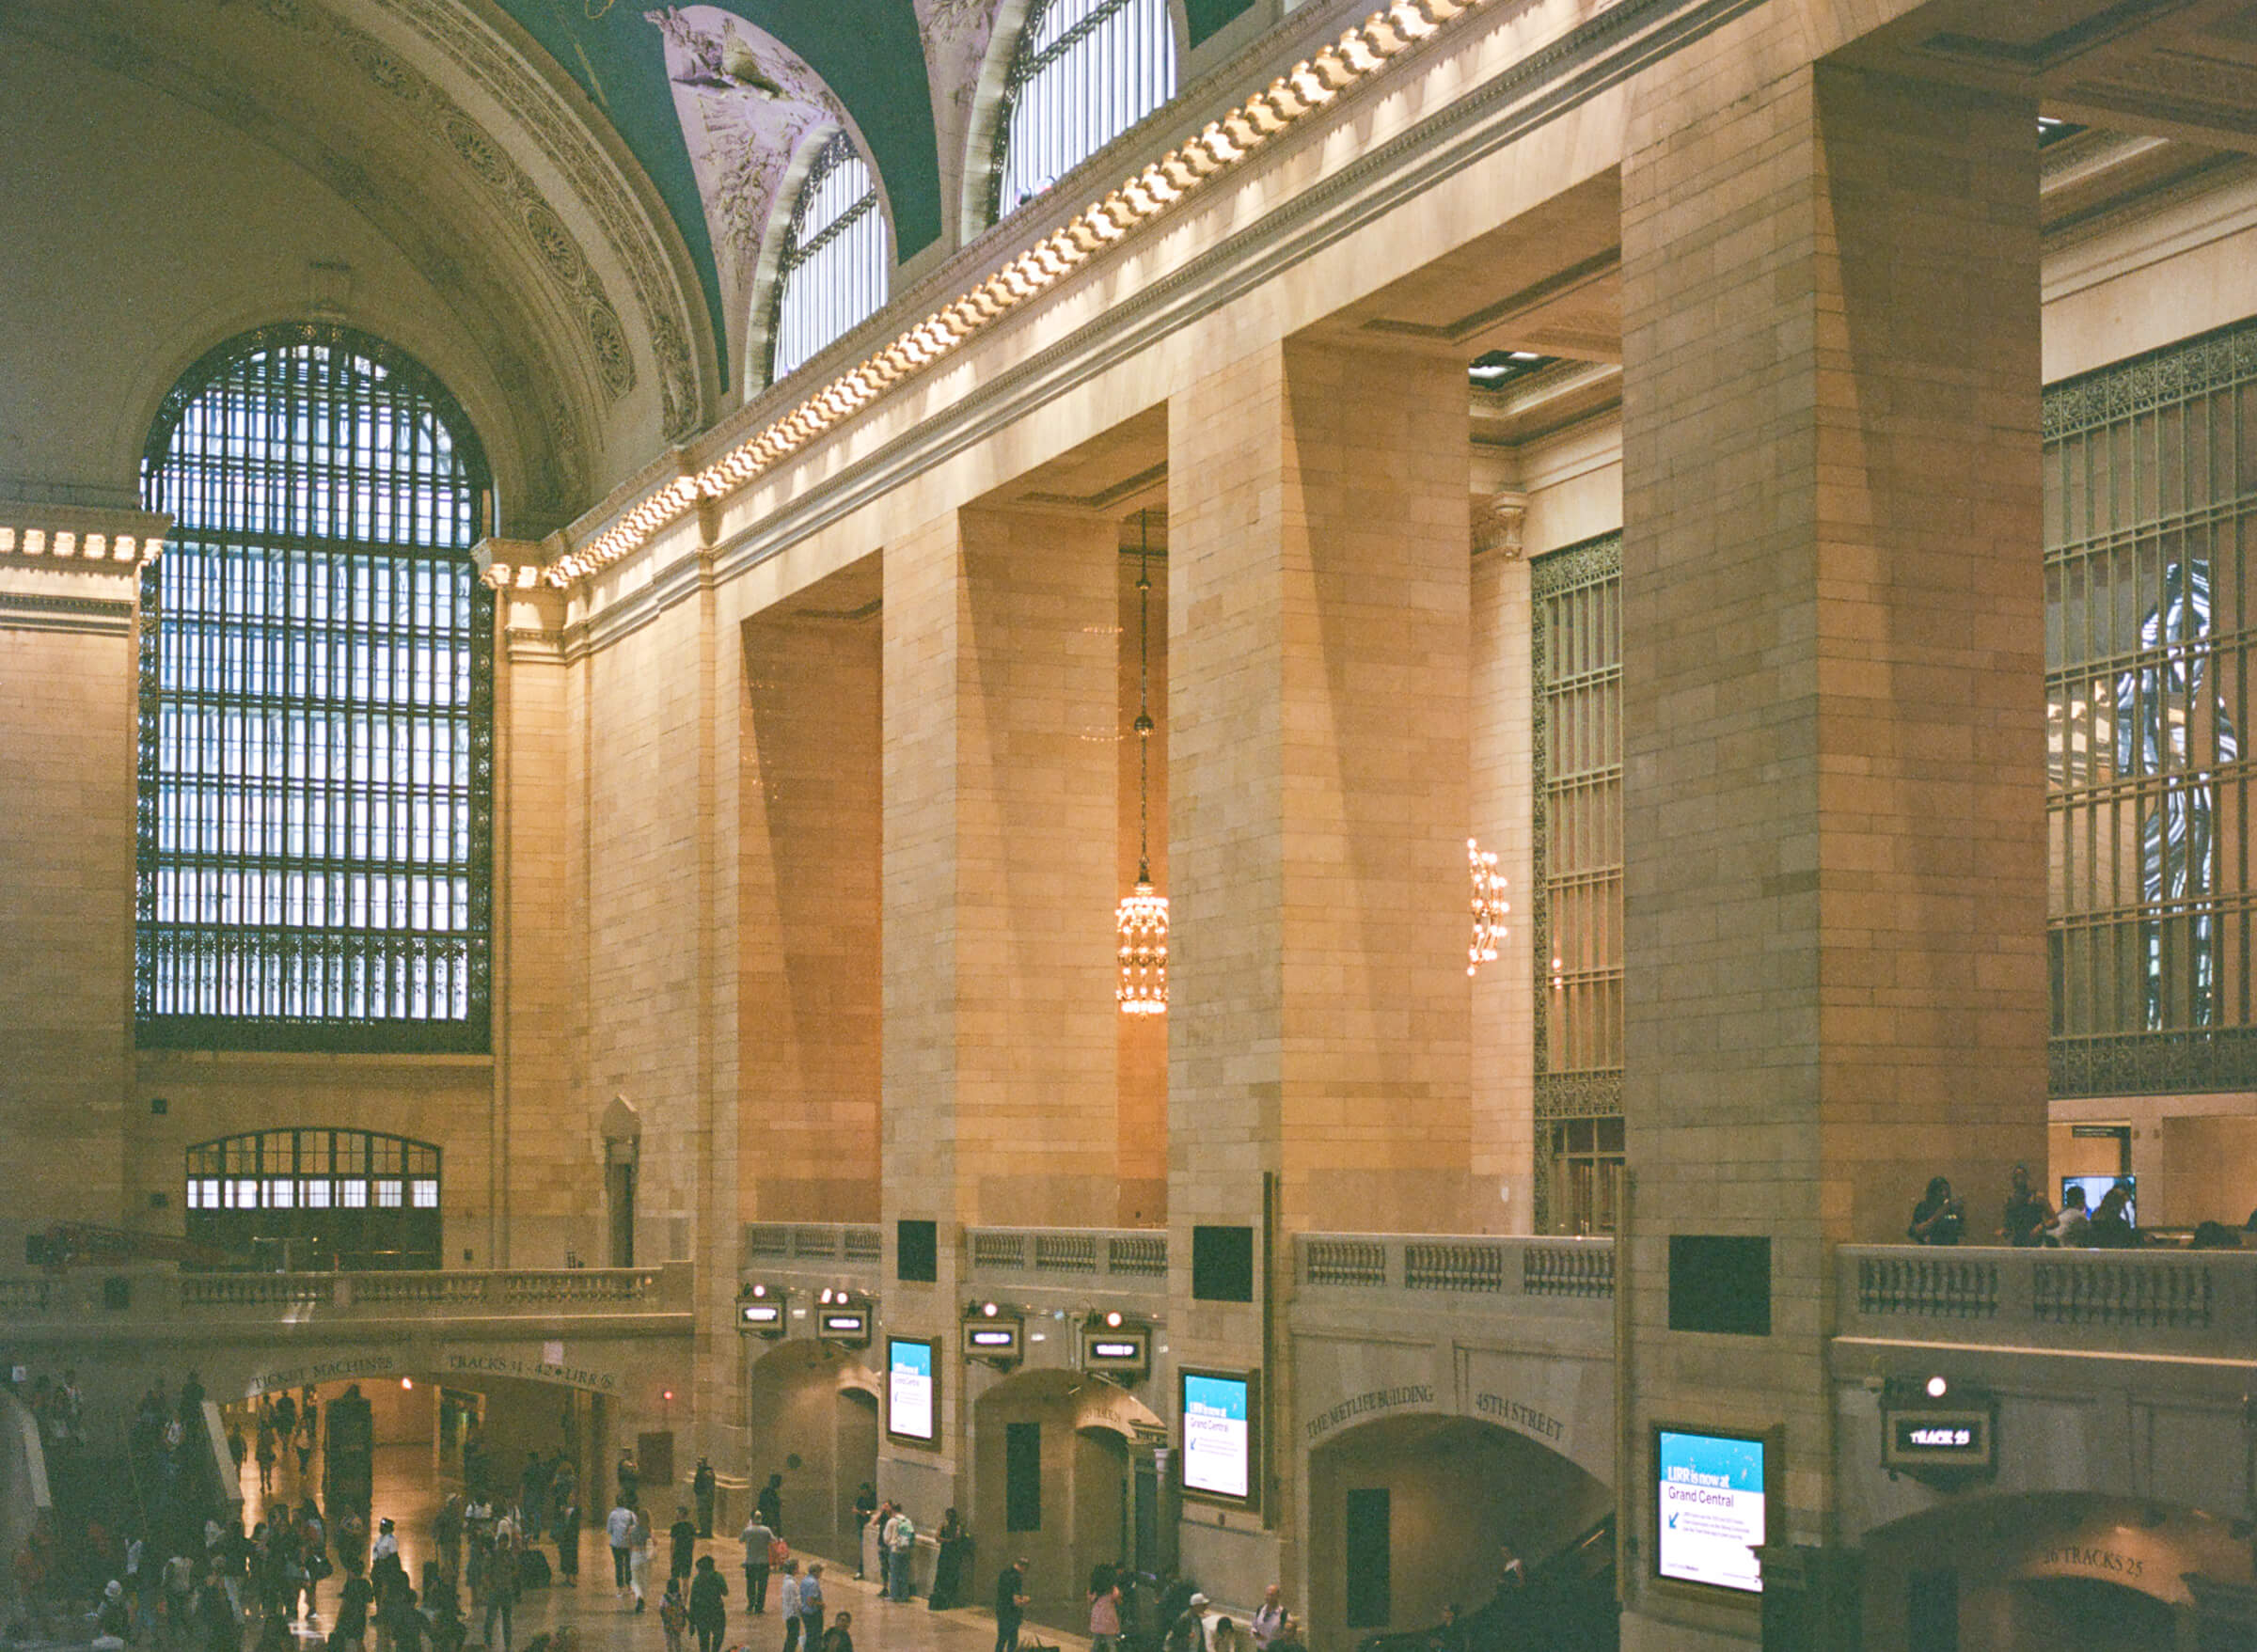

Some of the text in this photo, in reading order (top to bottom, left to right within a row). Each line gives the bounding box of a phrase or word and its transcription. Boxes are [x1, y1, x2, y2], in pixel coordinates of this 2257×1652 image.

[312, 1357, 393, 1377] MACHINES
[450, 1355, 506, 1371] TRACKS
[1306, 1385, 1433, 1438] THE METLIFE BUILDING
[1476, 1392, 1564, 1440] 45TH STREET
[1909, 1428, 1953, 1444] TRACK
[1667, 1466, 1729, 1488] LIRR is now at
[1668, 1486, 1734, 1508] Grand Central
[2063, 1546, 2123, 1571] TRACKS
[2126, 1557, 2142, 1578] 25
